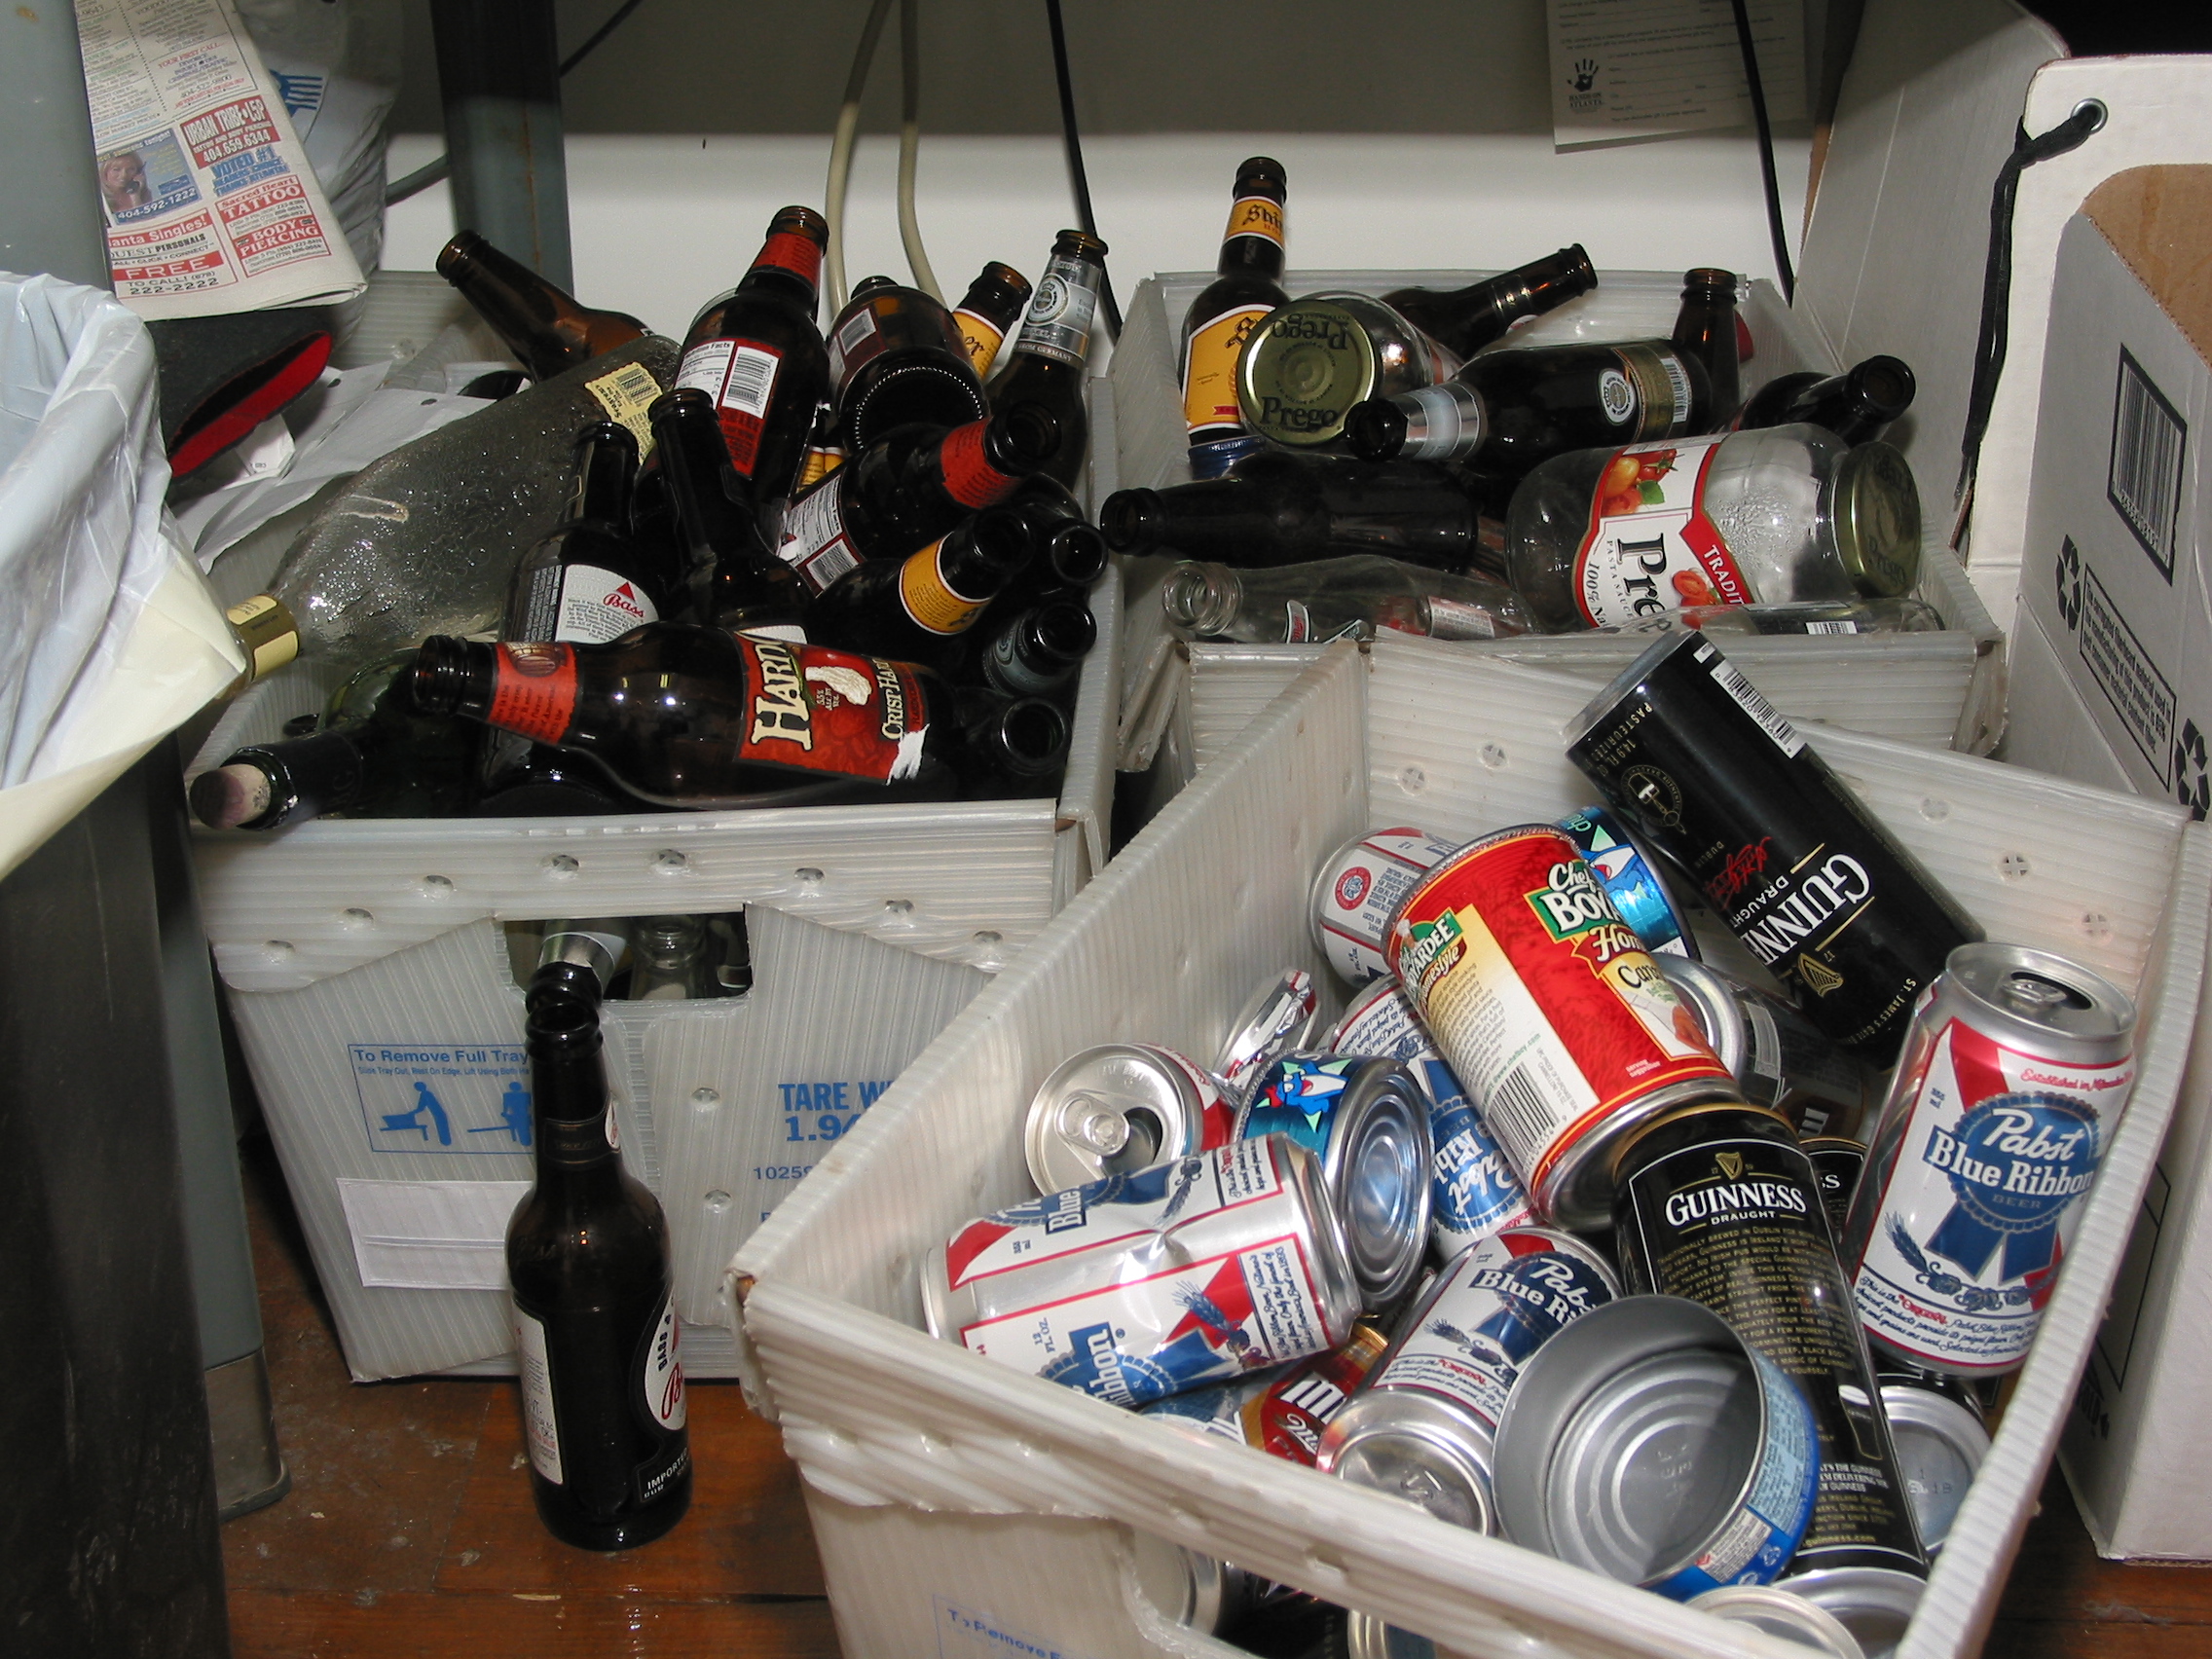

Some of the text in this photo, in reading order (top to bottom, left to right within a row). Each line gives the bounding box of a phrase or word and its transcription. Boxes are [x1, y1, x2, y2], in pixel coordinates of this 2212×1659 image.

[184, 104, 246, 146] URBAN TRIBE
[203, 129, 272, 163] 404.659.6344
[118, 186, 197, 220] 404-592-1222
[220, 177, 295, 207] Sacred Heart
[223, 185, 301, 219] TATTOO
[149, 216, 208, 241] Singles!
[156, 233, 206, 253] PERSONALS
[240, 226, 319, 257] PIERCING
[252, 219, 297, 241] BODY
[126, 256, 210, 279] FREE
[147, 276, 188, 285] CALL!
[129, 277, 220, 295] 222-2222
[1272, 313, 1348, 350] Prego
[1260, 396, 1340, 426] Prego
[1606, 540, 1617, 579] PASTA
[1586, 561, 1601, 602] 100%
[603, 593, 645, 618] Bass
[881, 689, 905, 740] CRISP
[1592, 702, 1652, 762] PASTEURIZED
[1614, 736, 1637, 759] 14.9
[1733, 876, 1788, 928] DRAUGHT
[1871, 976, 1918, 1030] ST. JAMES'S
[354, 1050, 529, 1065] To Remove Full Tray
[2021, 1068, 2080, 1090] Established
[778, 1082, 850, 1112] TARE
[1983, 1107, 2085, 1161] Pabst
[1929, 1129, 2093, 1198] Blue Ribbon
[1048, 1187, 1086, 1233] Blue
[1664, 1181, 1808, 1228] GUINNESS
[1992, 1194, 2043, 1209] BEER
[1710, 1210, 1777, 1226] DRAUGHT
[1699, 1239, 1738, 1256] GUINNESS
[1708, 1229, 1740, 1242] BREWED
[1752, 1226, 1782, 1235] DUBLIN
[1475, 1270, 1545, 1307] Blue
[1747, 1273, 1788, 1284] GUINNESS
[974, 1619, 1047, 1658] Remove
